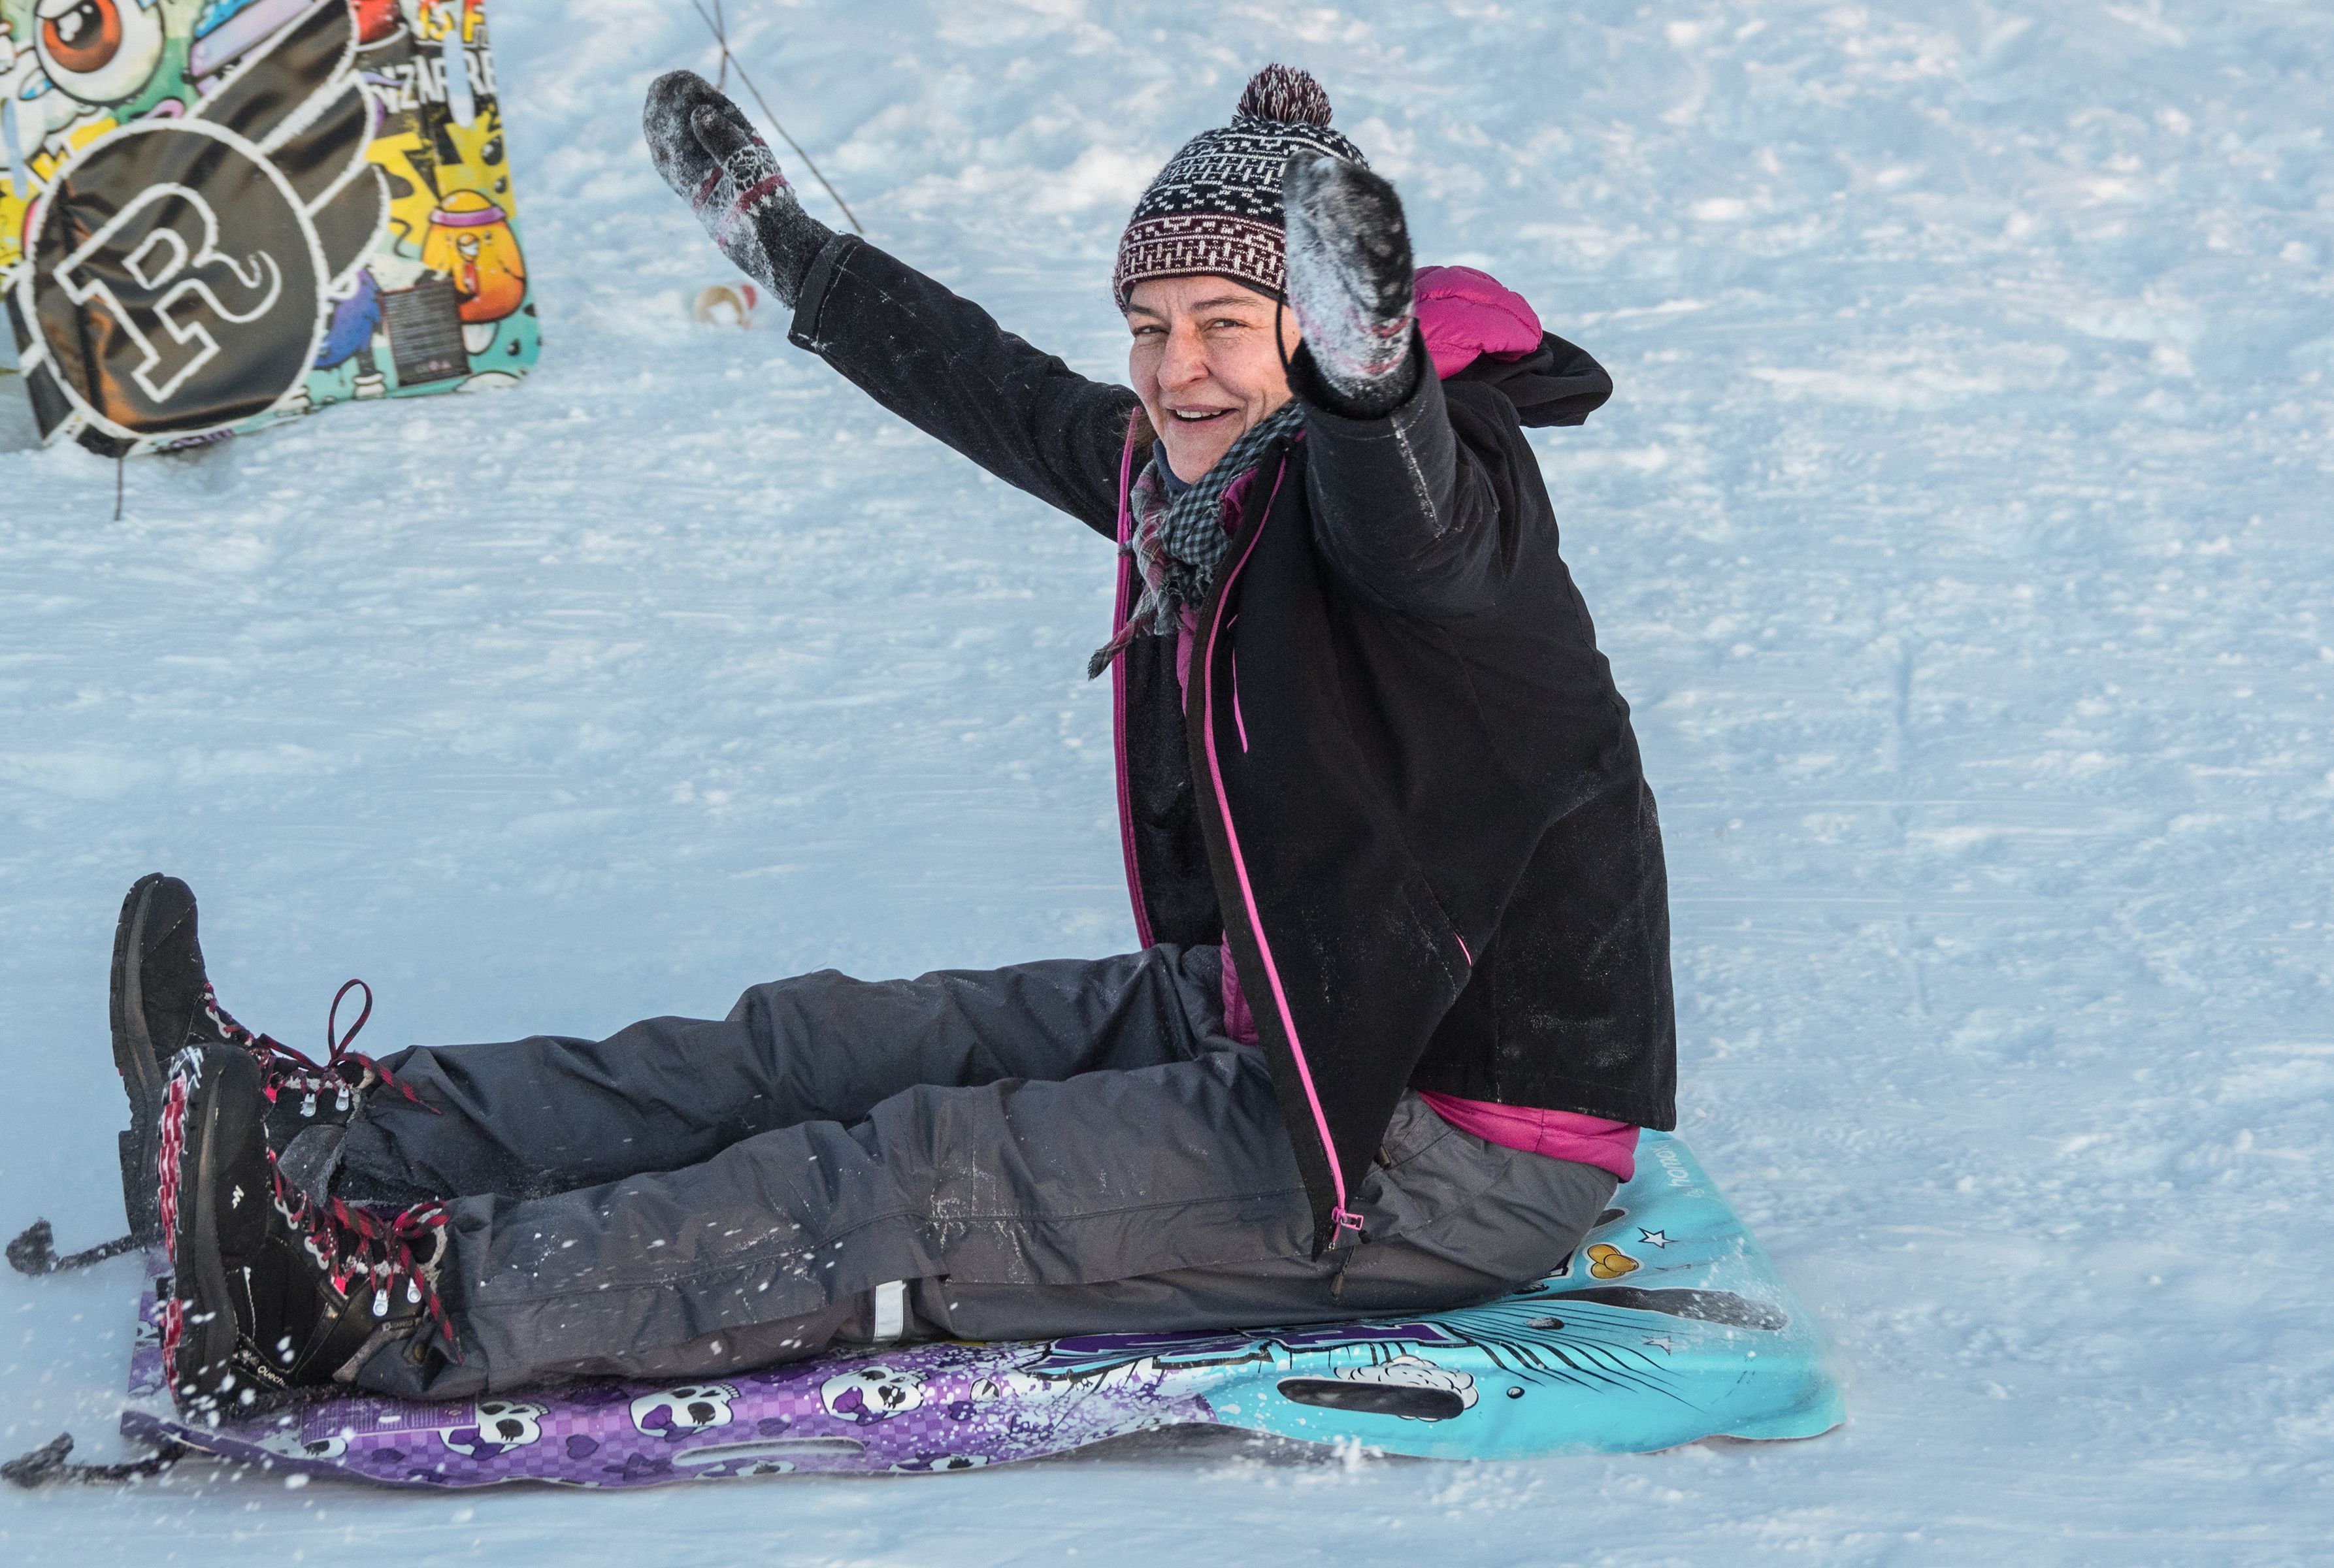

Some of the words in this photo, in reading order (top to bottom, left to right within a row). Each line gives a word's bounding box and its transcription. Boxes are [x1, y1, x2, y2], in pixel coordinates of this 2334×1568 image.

[375, 51, 497, 114] IZARRE
[52, 182, 283, 404] R
[257, 1365, 288, 1388] Quech
